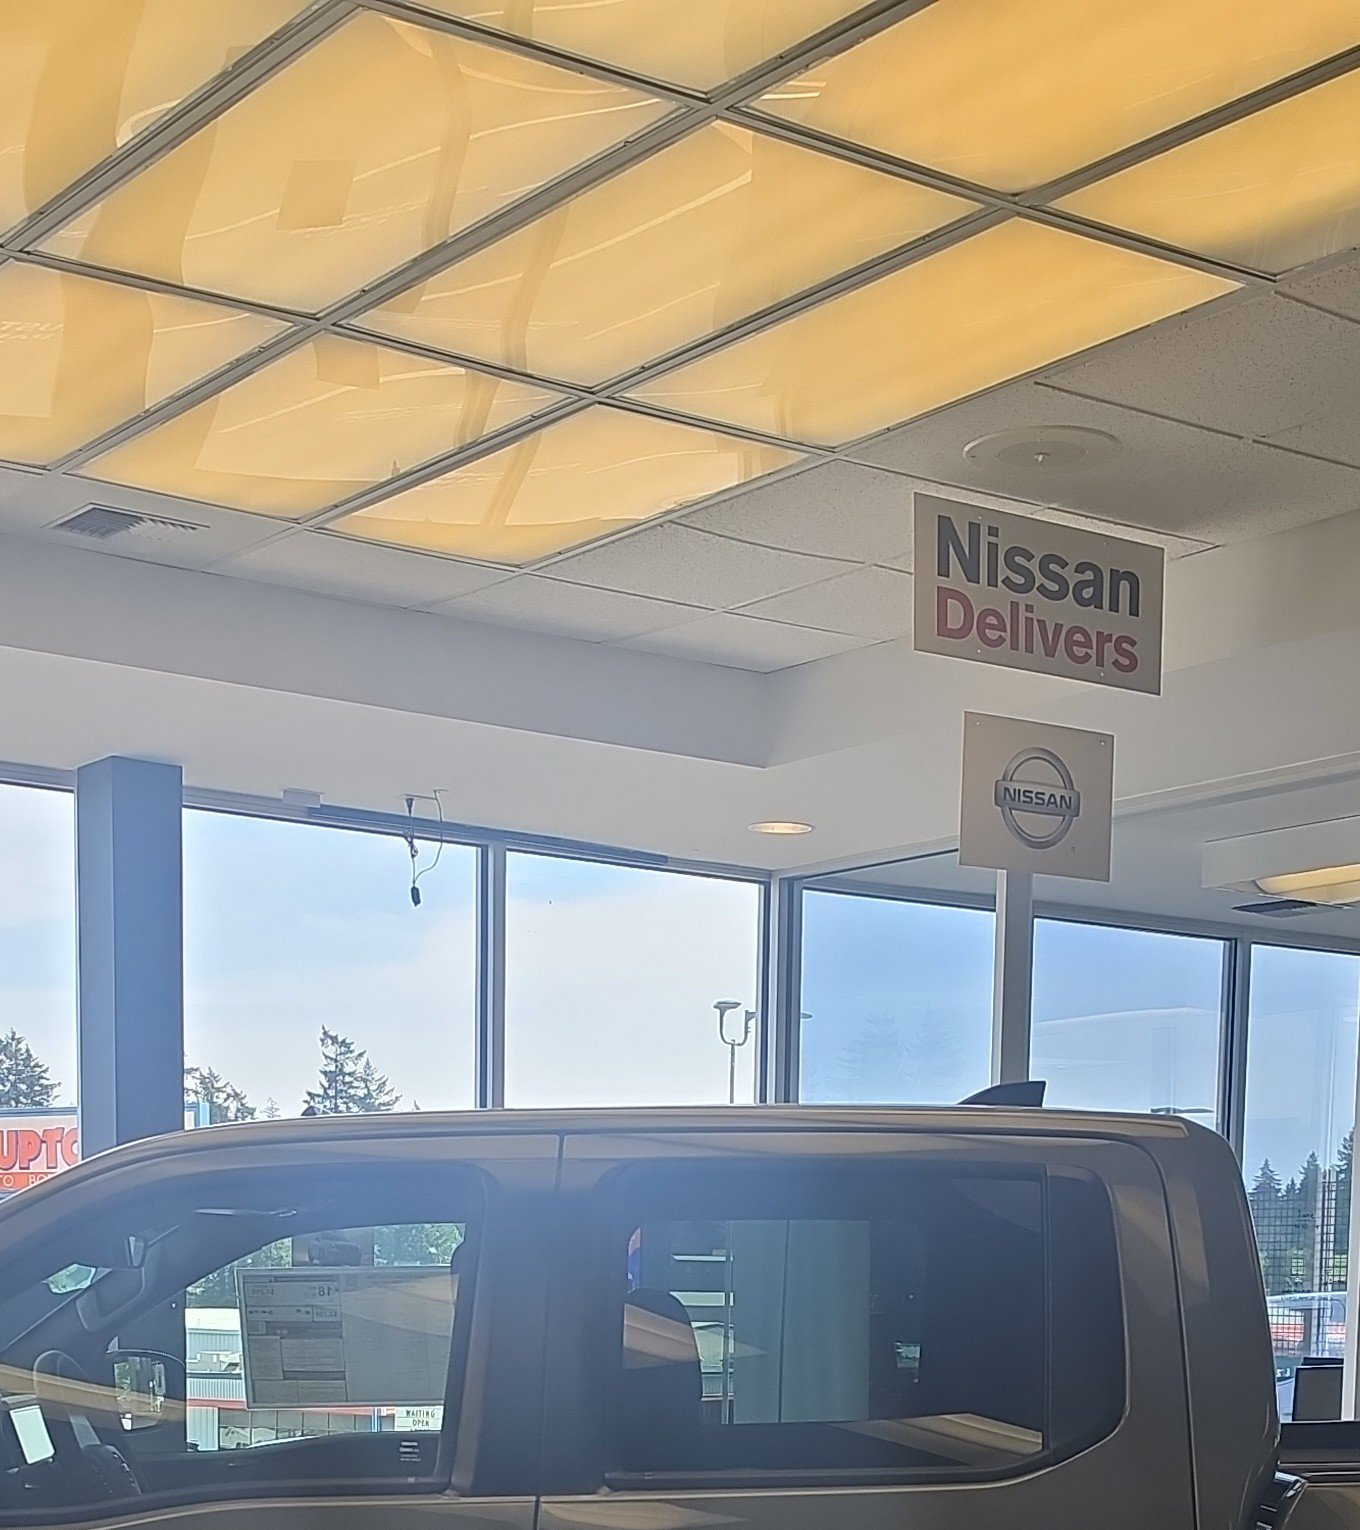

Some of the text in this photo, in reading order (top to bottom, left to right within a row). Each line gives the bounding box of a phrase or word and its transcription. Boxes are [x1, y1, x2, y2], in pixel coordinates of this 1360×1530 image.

[937, 513, 1140, 617] Nissan
[936, 585, 1139, 674] Delivers
[1003, 786, 1073, 810] NISSAN
